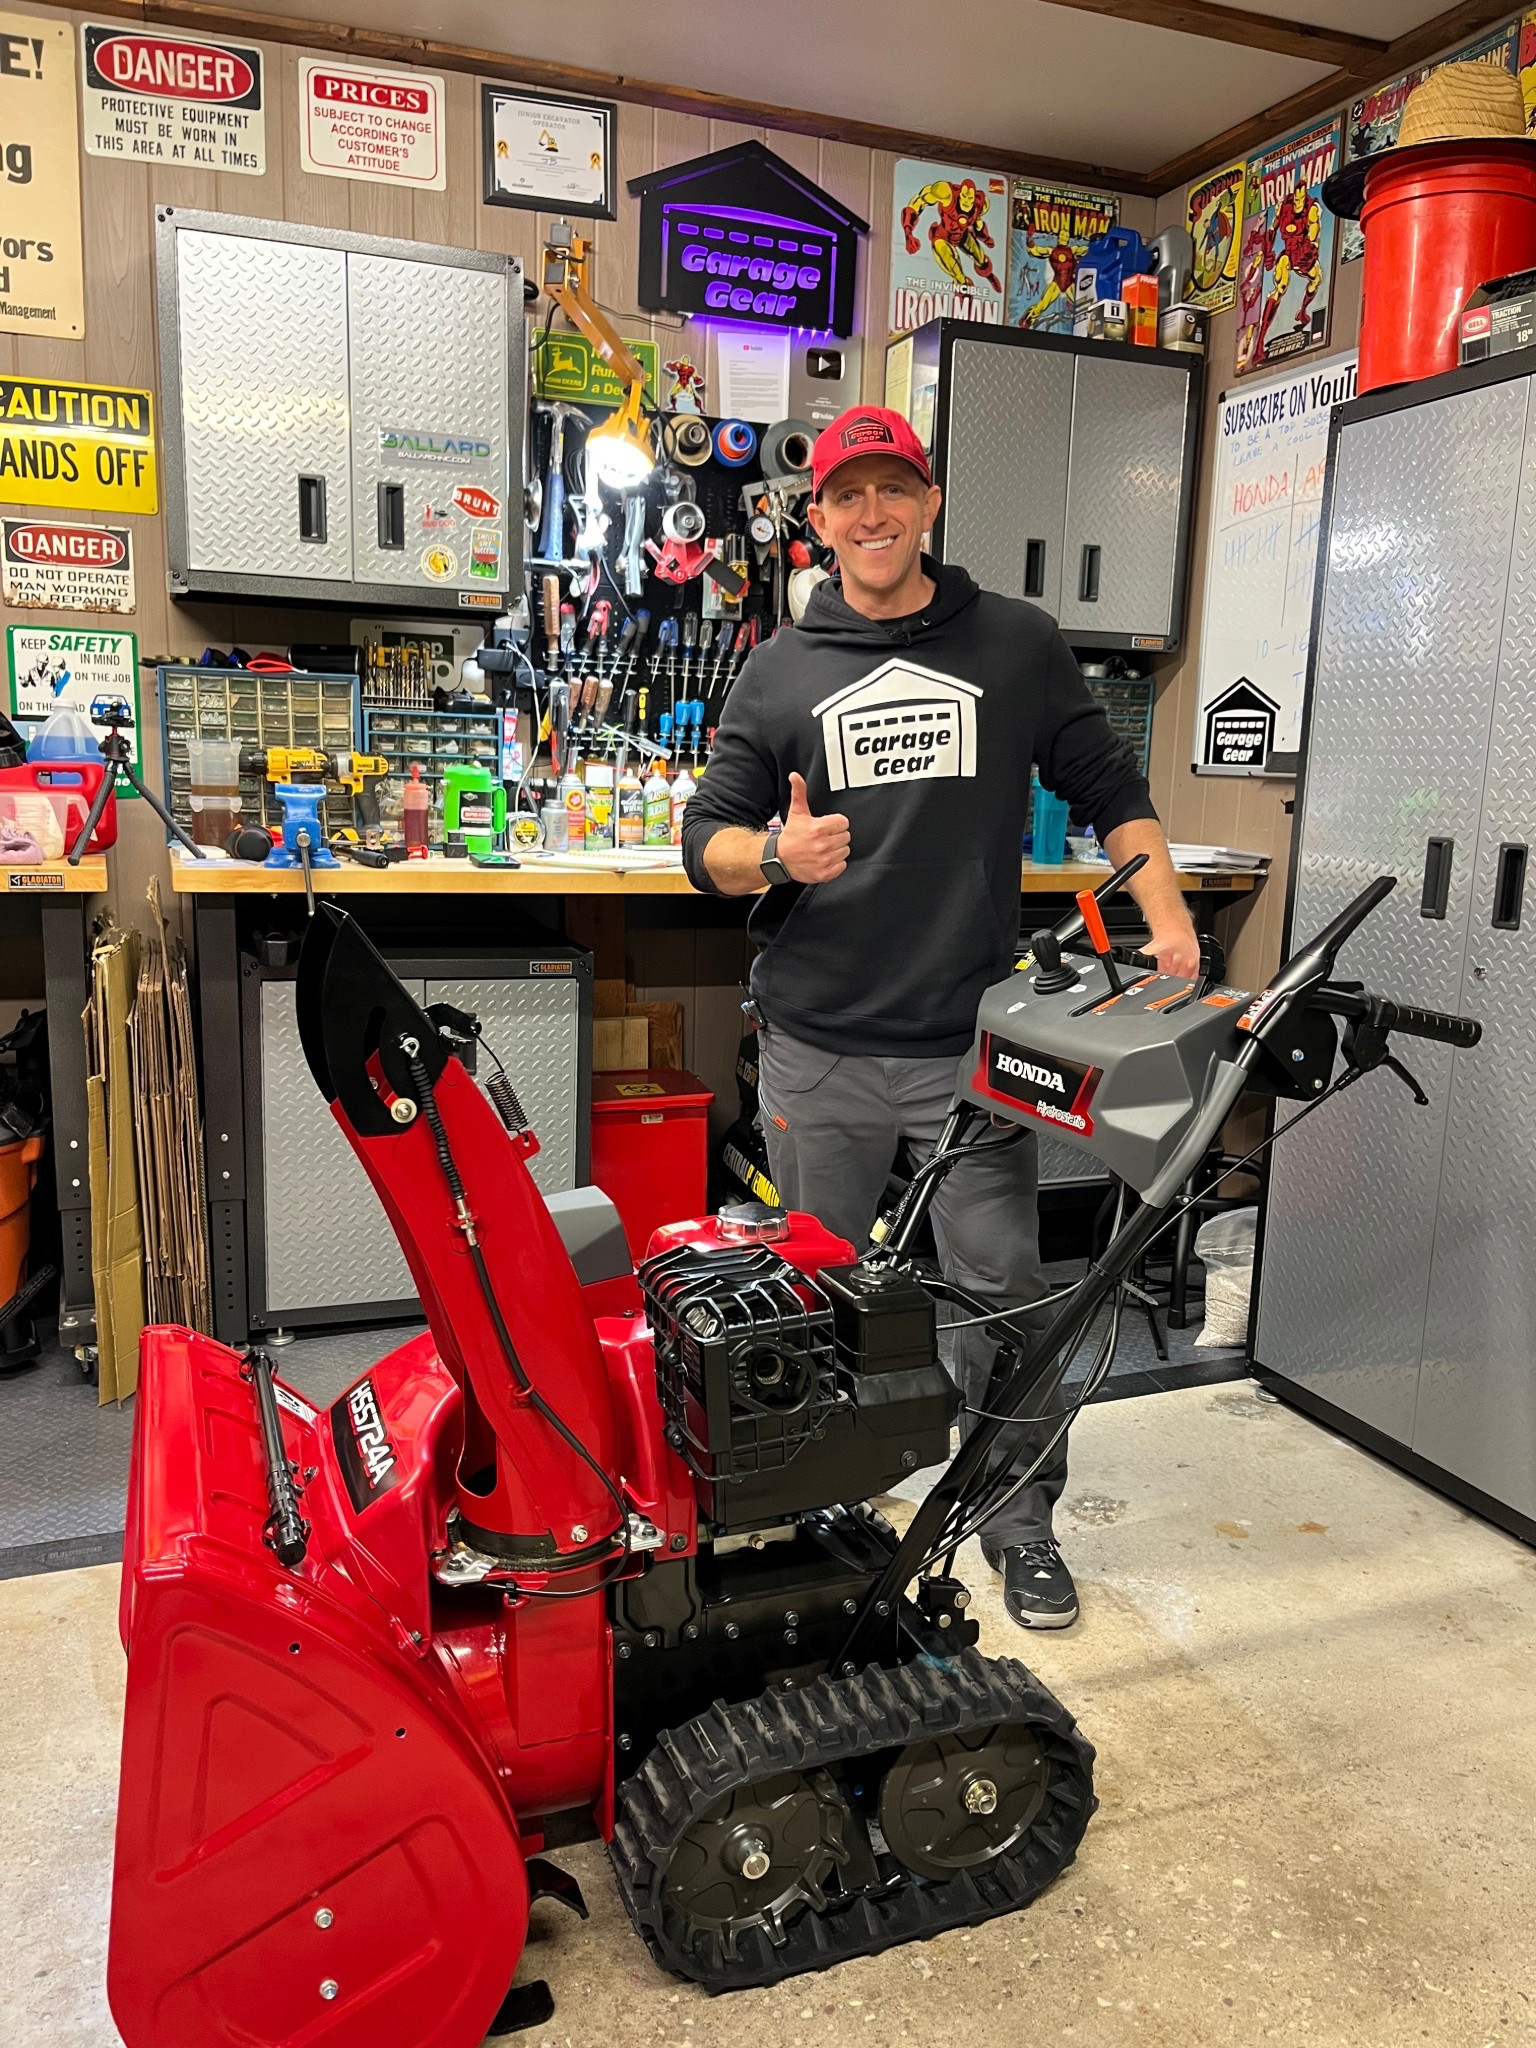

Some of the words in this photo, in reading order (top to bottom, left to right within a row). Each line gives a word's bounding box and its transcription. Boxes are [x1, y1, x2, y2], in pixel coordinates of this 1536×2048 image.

[113, 44, 235, 94] DANGER
[325, 79, 420, 110] PRICES
[101, 97, 174, 119] PROTECTIVE
[182, 107, 249, 129] EQUIPMENT
[314, 106, 365, 123] SUBJECT
[368, 114, 382, 126] TO
[386, 117, 432, 133] CHANGE
[115, 118, 148, 135] MUST
[158, 124, 173, 138] BE
[182, 126, 216, 144] WORN
[225, 132, 237, 146] IN
[331, 123, 398, 143] ACCORDING
[400, 134, 415, 145] TO
[1264, 149, 1286, 163] MARVEL
[1288, 134, 1311, 151] COMICS
[1312, 124, 1333, 140] GROUP
[95, 134, 123, 151] THIS
[133, 140, 163, 156] AREA
[172, 145, 186, 159] AT
[194, 148, 214, 163] ALL
[221, 150, 258, 168] TIMES
[338, 138, 409, 159] CUSTOMER'S
[1264, 158, 1281, 173] THE
[1282, 133, 1332, 165] INVINCIBLE
[347, 154, 400, 171] ATTITUDE
[1260, 168, 1296, 210] IRON
[1300, 148, 1336, 190] MAN
[1034, 193, 1051, 203] THE
[1054, 197, 1101, 211] INVINCIBLE
[1035, 186, 1062, 196] MARVEL
[1063, 191, 1089, 201] COMICS
[1189, 170, 1243, 222] SUPERMAN
[1034, 205, 1071, 233] IRON
[1074, 211, 1110, 236] MAN
[681, 244, 821, 290] Garage
[704, 281, 796, 317] Gear
[905, 276, 926, 288] THE
[931, 280, 990, 297] INVINCIBLE
[895, 287, 949, 331] IRON
[952, 296, 999, 326] MAN
[1492, 305, 1522, 320] TRACTION
[1468, 318, 1485, 330] BELL
[1224, 388, 1287, 436] SUBSCRIBE
[1290, 381, 1308, 417] ON
[380, 433, 491, 458] BALLARD
[1247, 433, 1260, 446] BE
[1279, 422, 1296, 435] TOP
[96, 445, 149, 487] OFF
[453, 491, 501, 516] BRUNT
[1233, 471, 1288, 516] HONDA
[17, 531, 119, 560] DANGER
[9, 567, 29, 578] DO
[36, 569, 63, 580] NOT
[68, 571, 130, 586] OPERATE
[10, 581, 46, 591] MAN
[52, 583, 129, 598] WORKING
[19, 592, 41, 601] ON
[50, 594, 121, 606] REPAIRS
[20, 638, 46, 650] KEEP
[48, 634, 123, 653] SAFETY
[80, 653, 91, 665] IN
[93, 654, 121, 666] MIND
[74, 671, 89, 681] ON
[91, 673, 110, 683] THE
[113, 673, 131, 683] JOB
[19, 701, 33, 711] ON
[36, 702, 53, 711] THE
[854, 729, 951, 756] Garage
[1216, 731, 1263, 747] Garage
[873, 754, 936, 777] Gear
[1222, 748, 1254, 762] Gear
[21, 875, 62, 885] GLADIATOR
[996, 1053, 1066, 1093] HONDA
[1036, 1100, 1086, 1130] Hydrostatic
